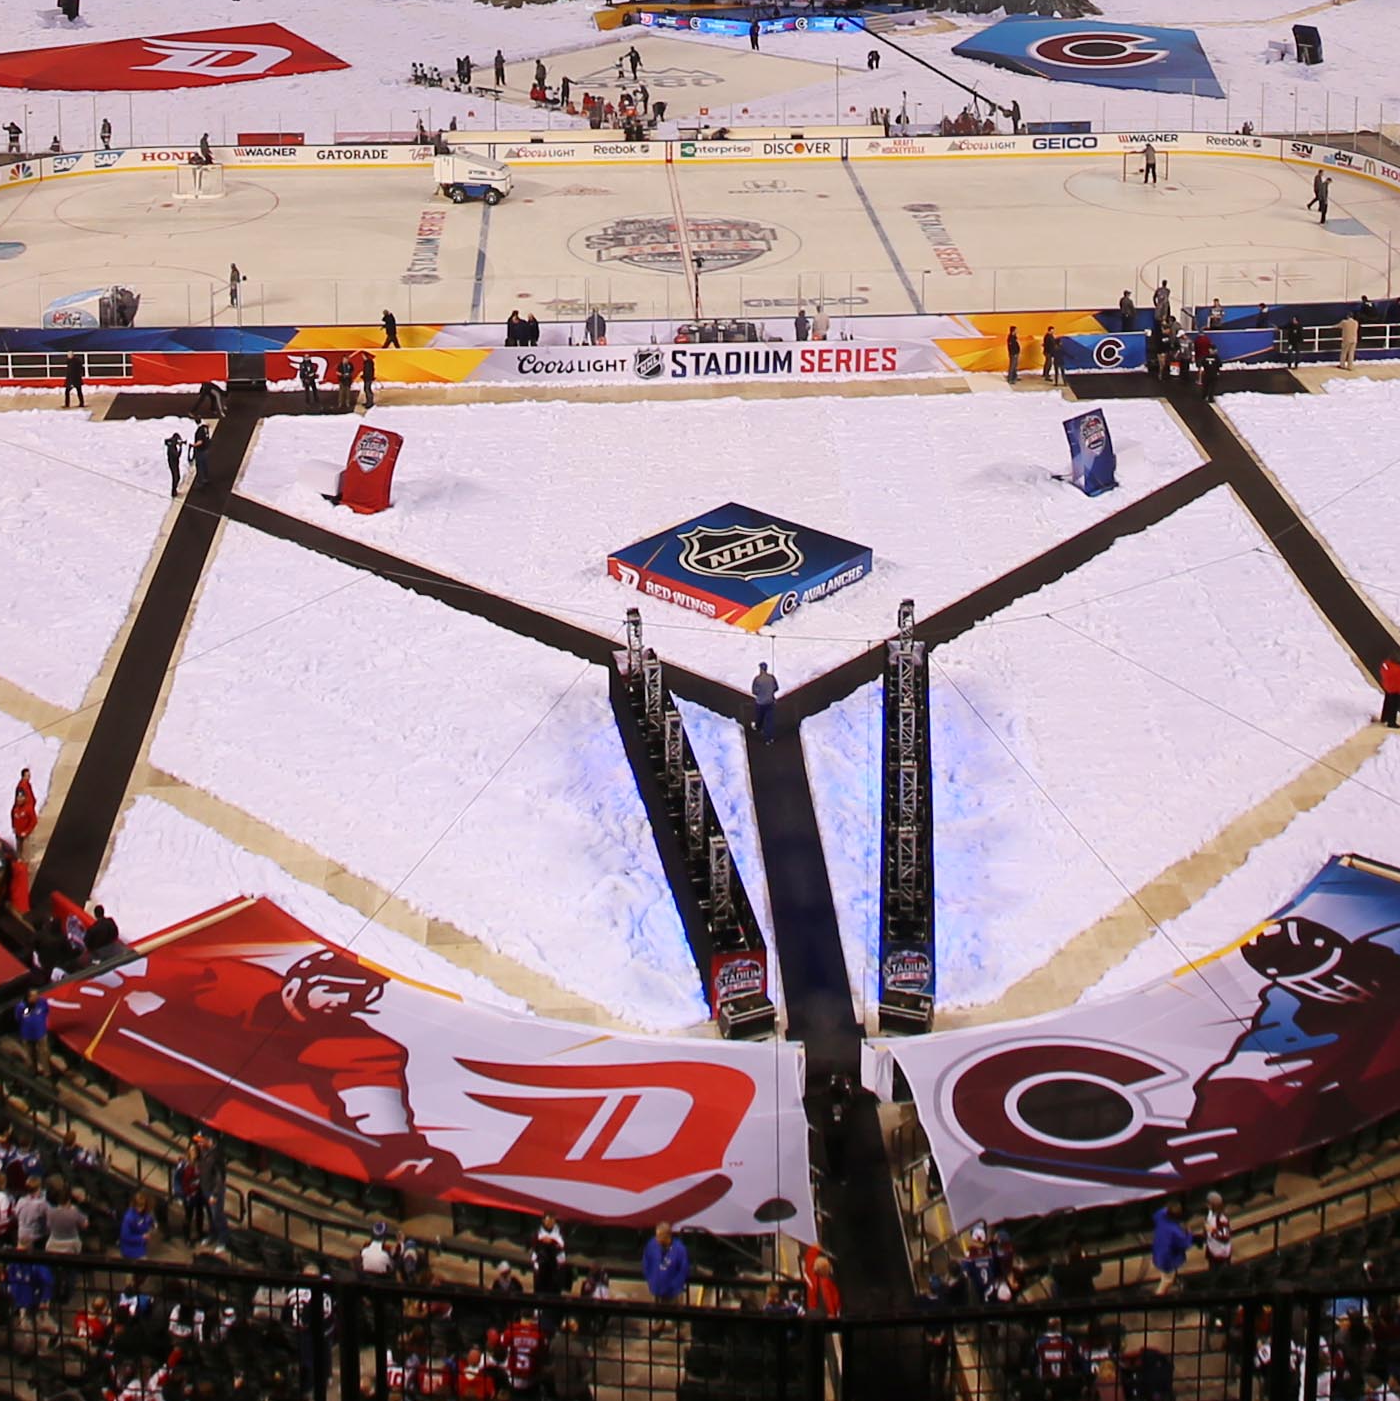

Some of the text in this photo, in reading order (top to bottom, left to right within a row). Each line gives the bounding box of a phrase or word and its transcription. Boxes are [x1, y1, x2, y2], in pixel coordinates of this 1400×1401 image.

[958, 140, 1016, 151] Coors LIGHT
[1032, 136, 1098, 150] GEICO
[1128, 134, 1179, 144] WAGNER
[1206, 135, 1249, 148] Reebok
[245, 147, 297, 158] WAGNER
[316, 149, 389, 161] GATORADE
[516, 148, 575, 159] Coors LIGHT
[593, 142, 637, 155] Reebok
[763, 142, 831, 155] DISCOVER
[1291, 143, 1313, 155] SN
[95, 152, 118, 167] SAP
[141, 151, 200, 162] HOND
[54, 156, 77, 172] SAP
[406, 210, 447, 272] STADIUM SERIES
[585, 229, 778, 248] STADIUM
[911, 213, 973, 276] STADIUM SERIES
[743, 297, 870, 309] GEICO
[517, 354, 575, 375] Coors
[577, 358, 627, 373] LIGHT
[671, 350, 792, 377] STADIUM
[800, 346, 898, 373] SERIES
[708, 538, 776, 569] NHL
[801, 565, 865, 603] AVALANCHE
[645, 580, 717, 617] RED WINGS
[884, 962, 930, 975] STADIUM
[718, 969, 762, 985] STADIUM
